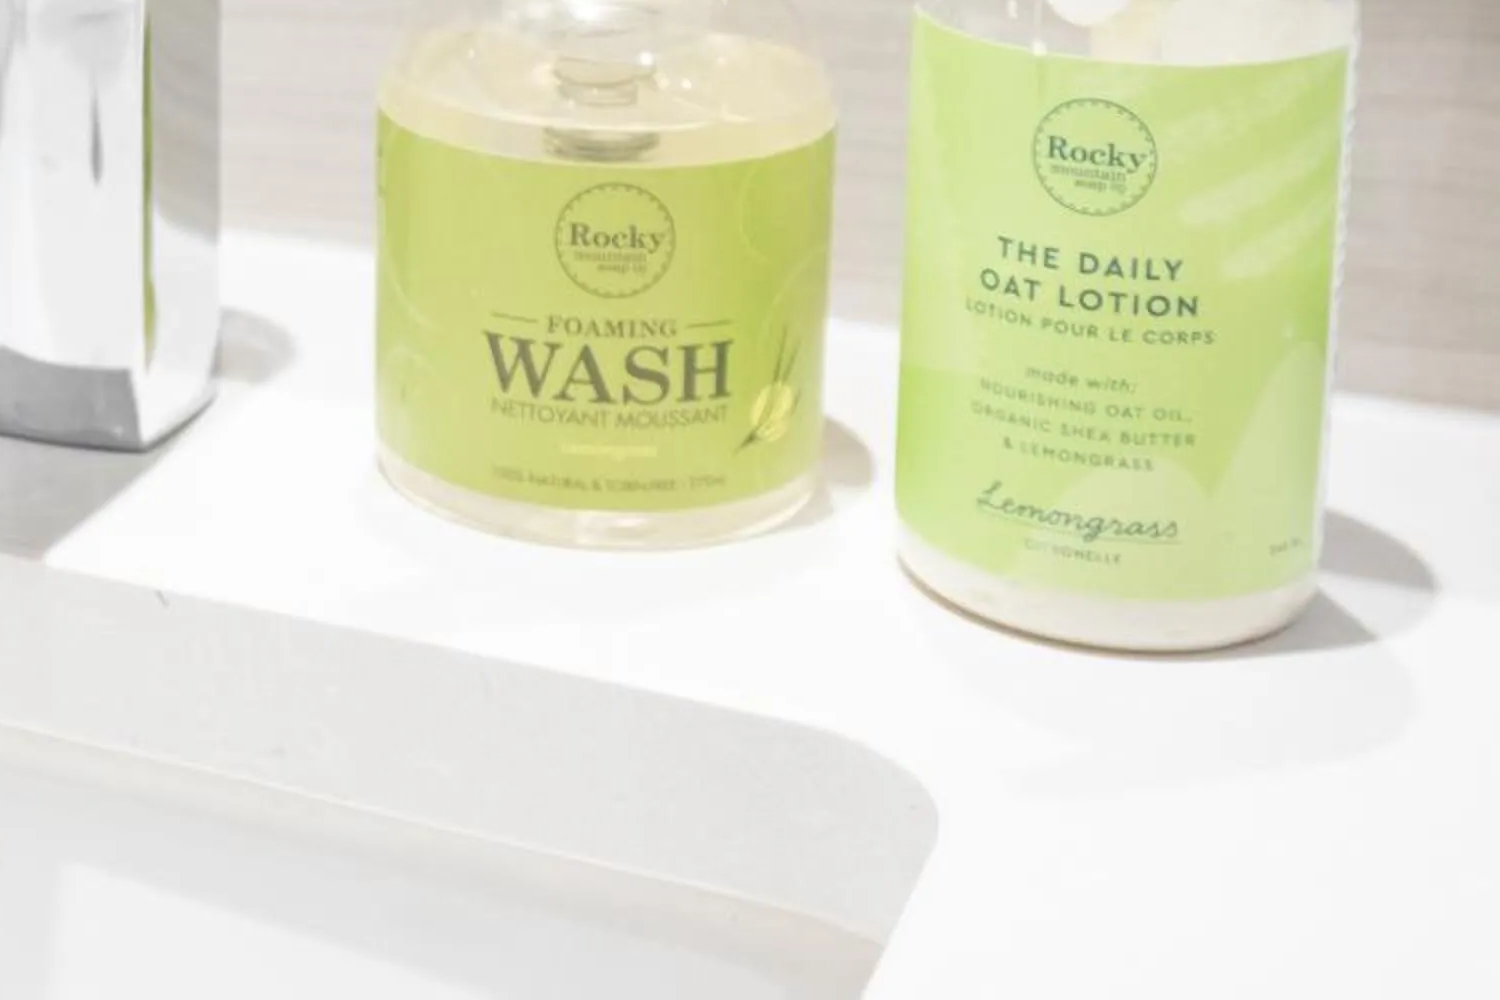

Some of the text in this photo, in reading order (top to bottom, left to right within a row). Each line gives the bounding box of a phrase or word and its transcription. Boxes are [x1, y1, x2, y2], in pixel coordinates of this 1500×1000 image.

[1047, 135, 1148, 174] Rocky
[569, 222, 665, 255] Rocky
[997, 234, 1183, 282] THE DAILY
[980, 268, 1198, 317] OAT LOTION
[546, 314, 678, 339] FOAMING
[965, 297, 1215, 346] LOTION POUR LE CORPS
[481, 329, 735, 406] WASH
[1025, 366, 1079, 388] made
[490, 399, 729, 431] NETTOYANT MOUSSANT
[980, 377, 1097, 416] NOURISHING
[1105, 403, 1145, 419] OAT
[970, 400, 1198, 449] ORGANIC SHEA BUTTER
[1020, 440, 1156, 473] LEMONGRASS
[976, 479, 1181, 544] Lemongrass
